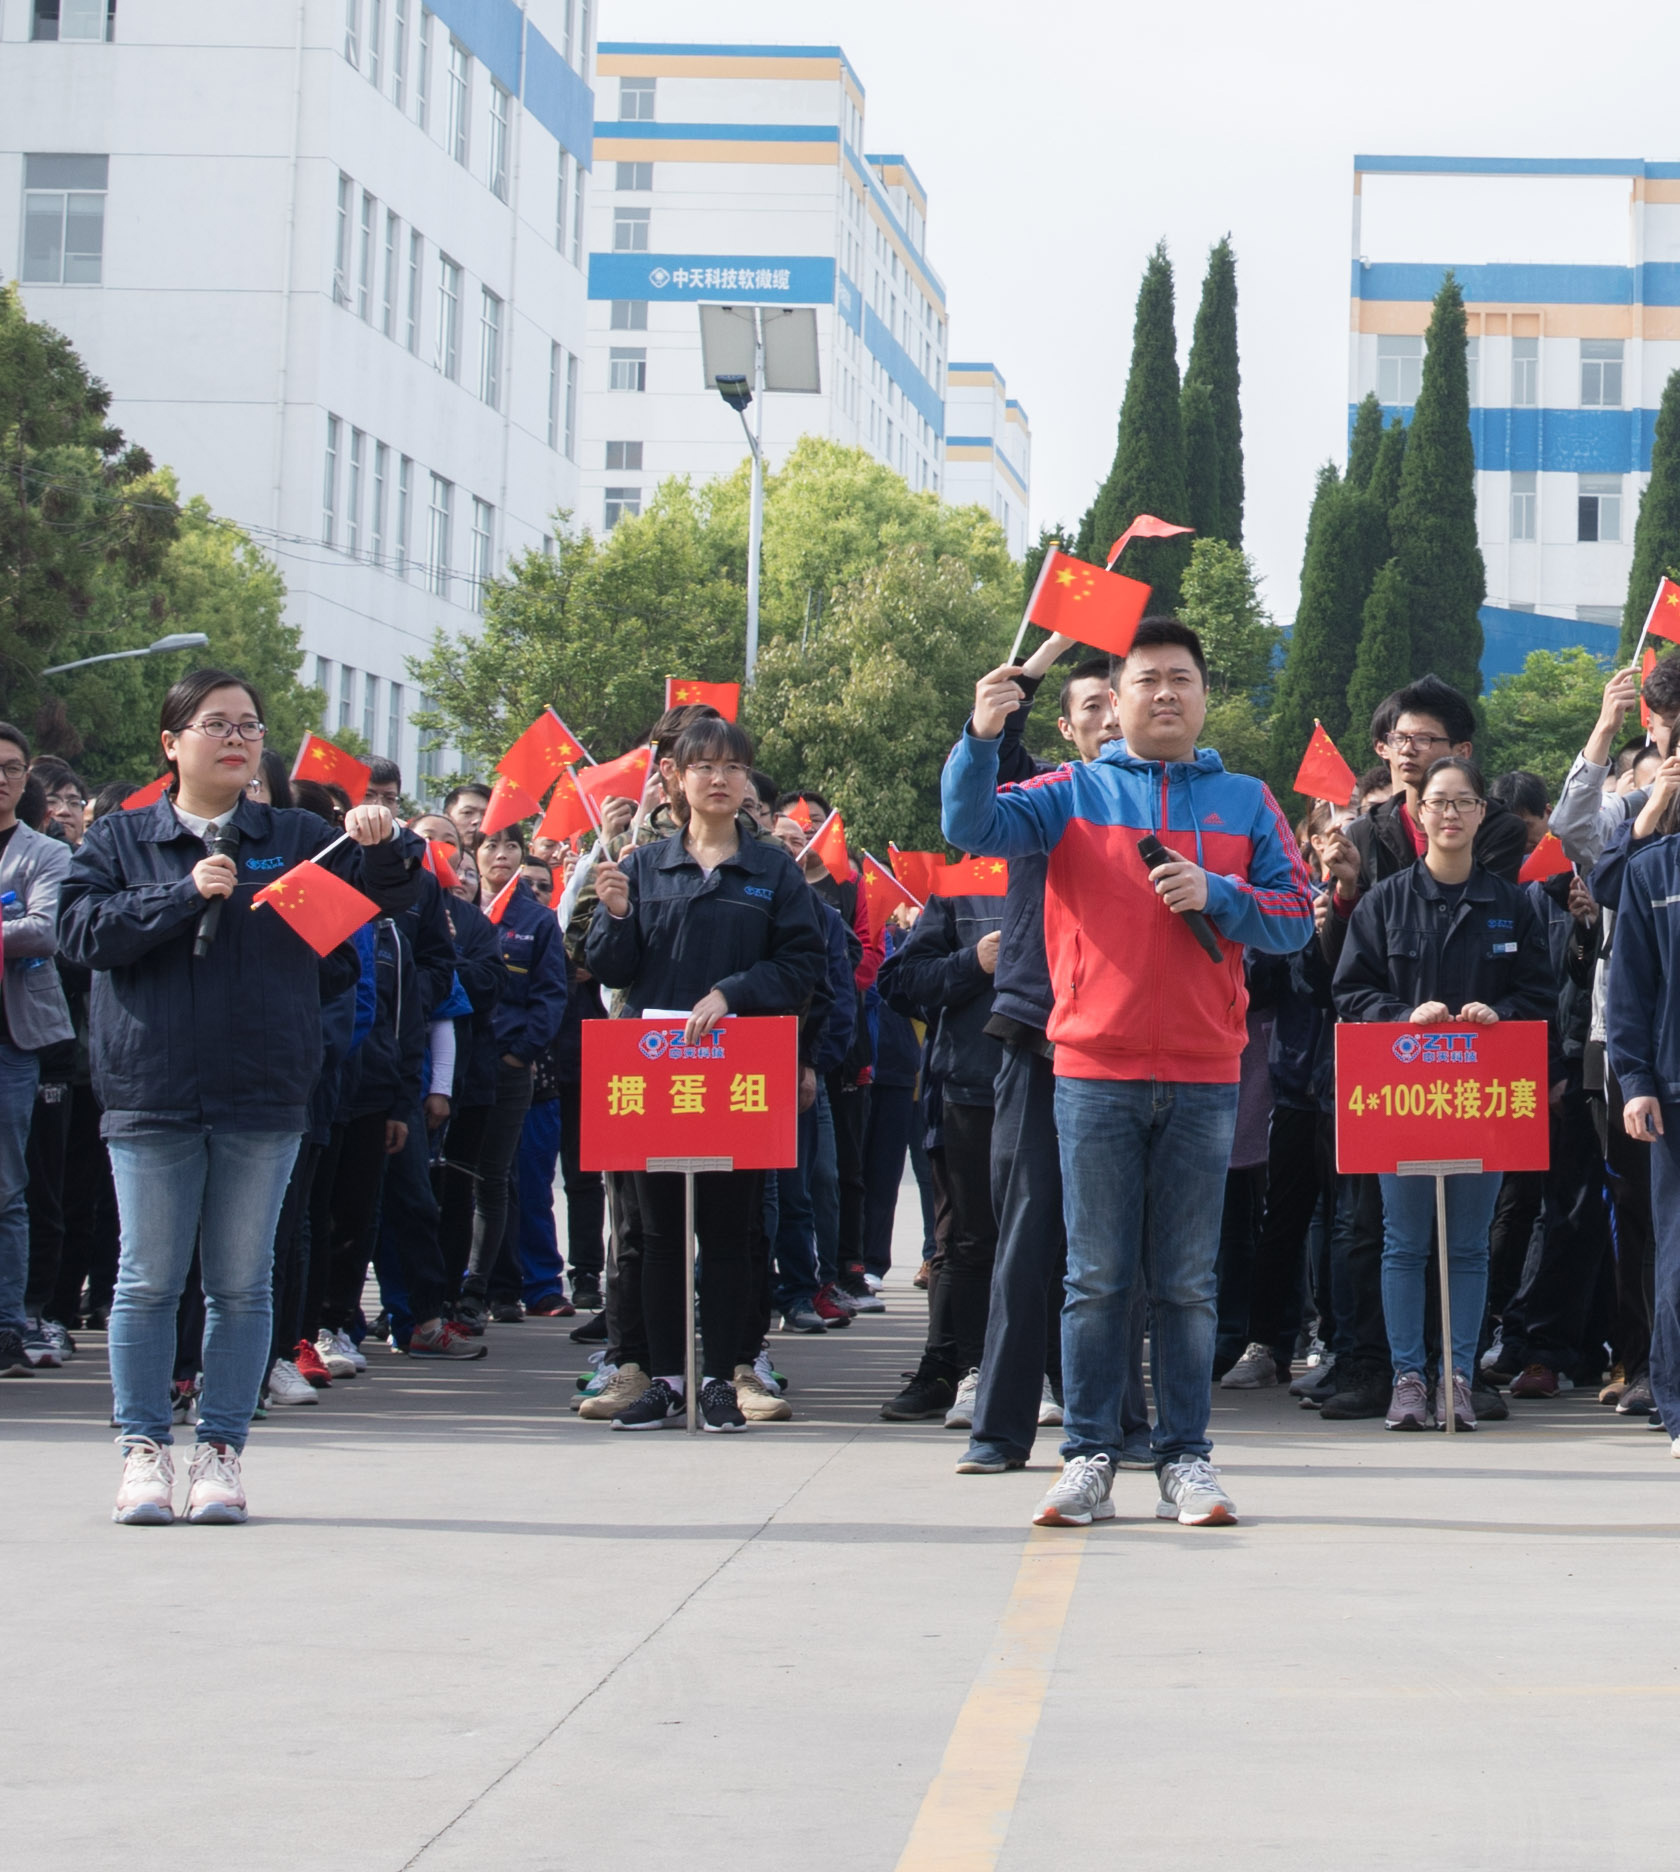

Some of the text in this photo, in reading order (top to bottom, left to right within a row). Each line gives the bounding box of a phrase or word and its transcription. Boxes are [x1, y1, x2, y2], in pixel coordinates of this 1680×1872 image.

[672, 267, 791, 290] 中天科技软微缆
[1422, 1033, 1478, 1050] ZTT
[607, 1073, 769, 1116] 掼蛋组
